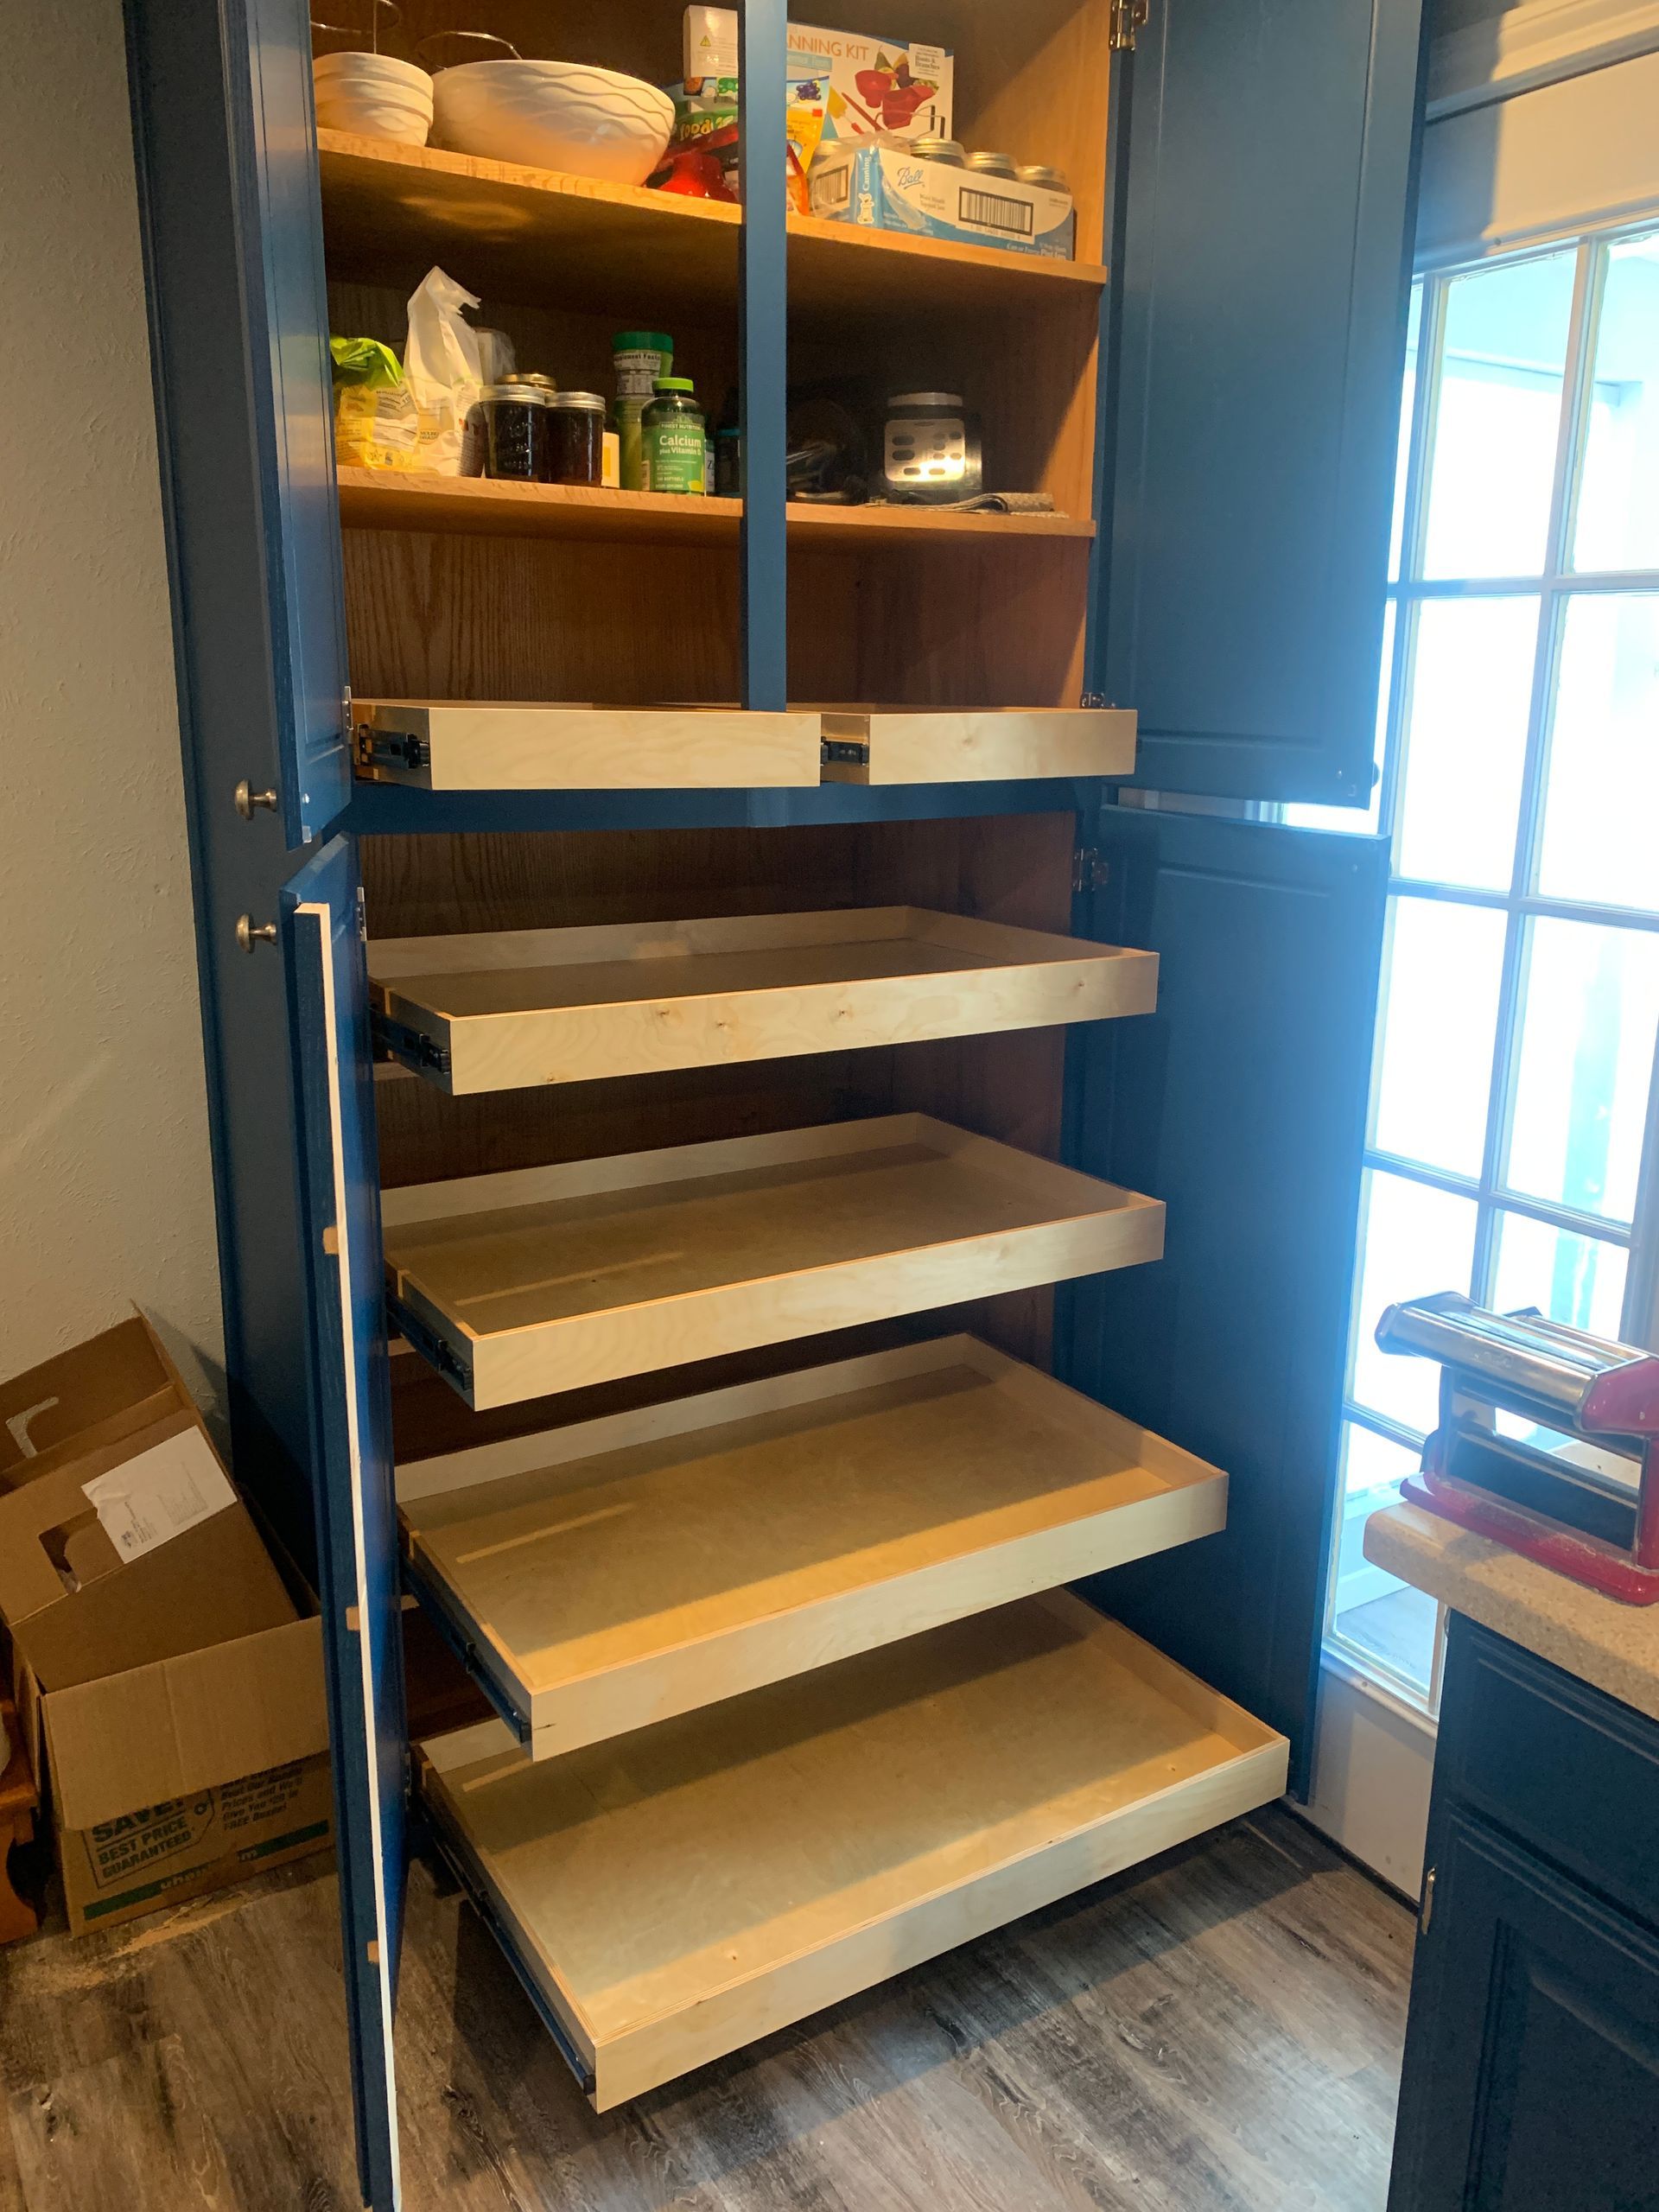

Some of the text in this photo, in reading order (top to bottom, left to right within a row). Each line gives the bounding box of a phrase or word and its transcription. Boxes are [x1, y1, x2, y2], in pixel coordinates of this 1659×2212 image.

[846, 44, 869, 61] KIT
[897, 166, 925, 190] Ball
[659, 435, 702, 448] Calcium
[671, 447, 697, 456] Vitamin
[99, 1815, 188, 1866] BEST PRICE
